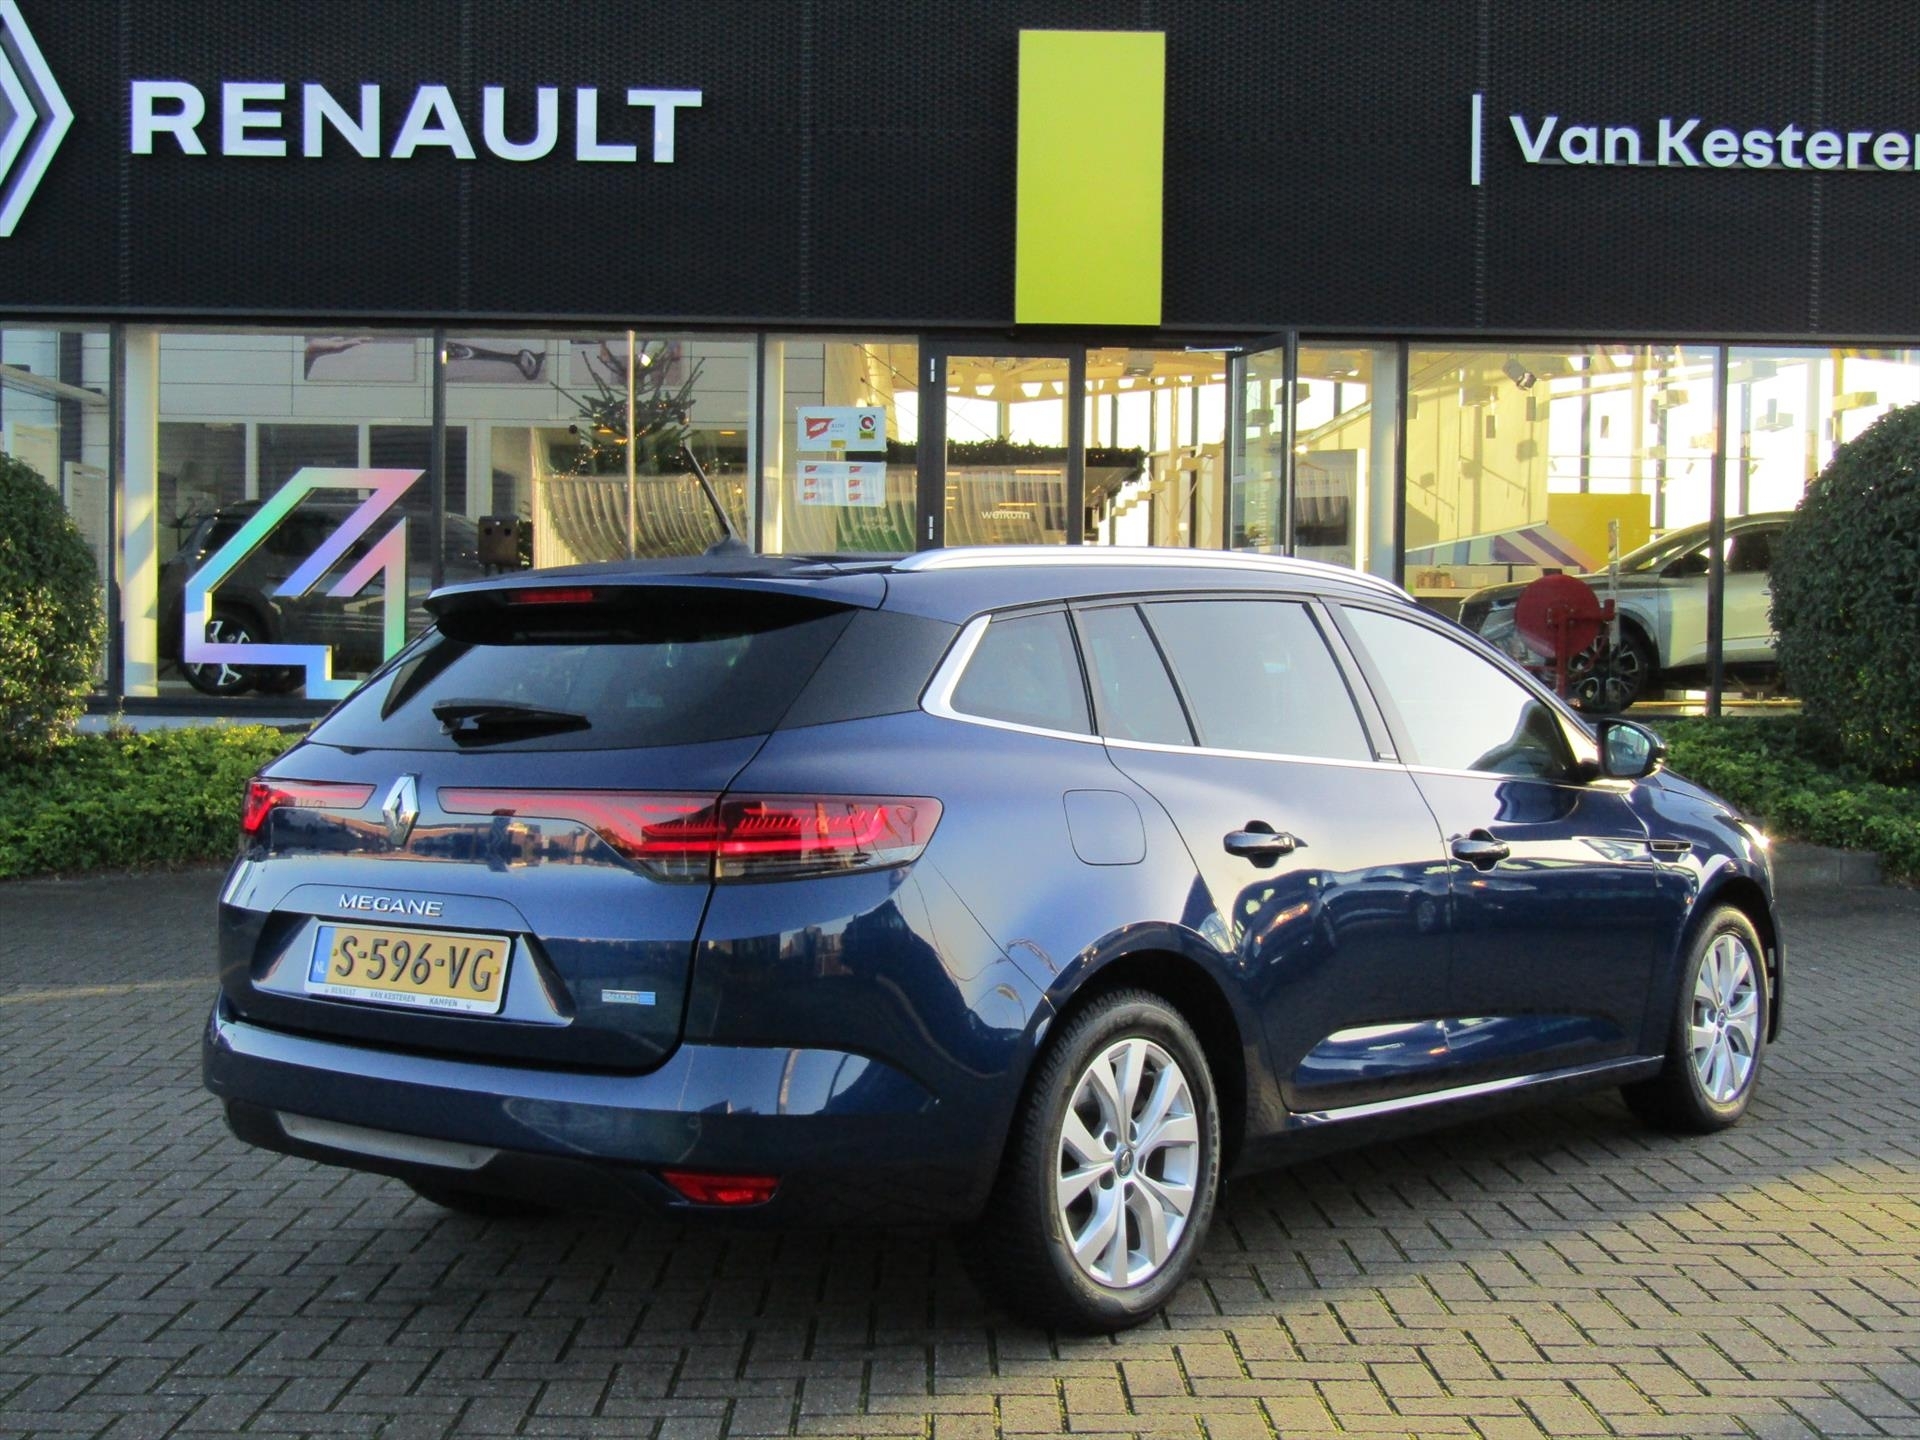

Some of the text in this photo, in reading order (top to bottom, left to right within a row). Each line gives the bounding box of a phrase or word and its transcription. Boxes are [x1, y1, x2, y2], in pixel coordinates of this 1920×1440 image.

[131, 80, 703, 163] RENAULT
[1509, 115, 1920, 171] Van Kestere
[338, 893, 444, 918] MEGANE
[314, 961, 326, 975] NL
[335, 935, 495, 993] S-596-VG
[369, 990, 383, 1000] VAN
[383, 991, 417, 1003] KESTEREN
[428, 997, 459, 1008] KAMPEN
